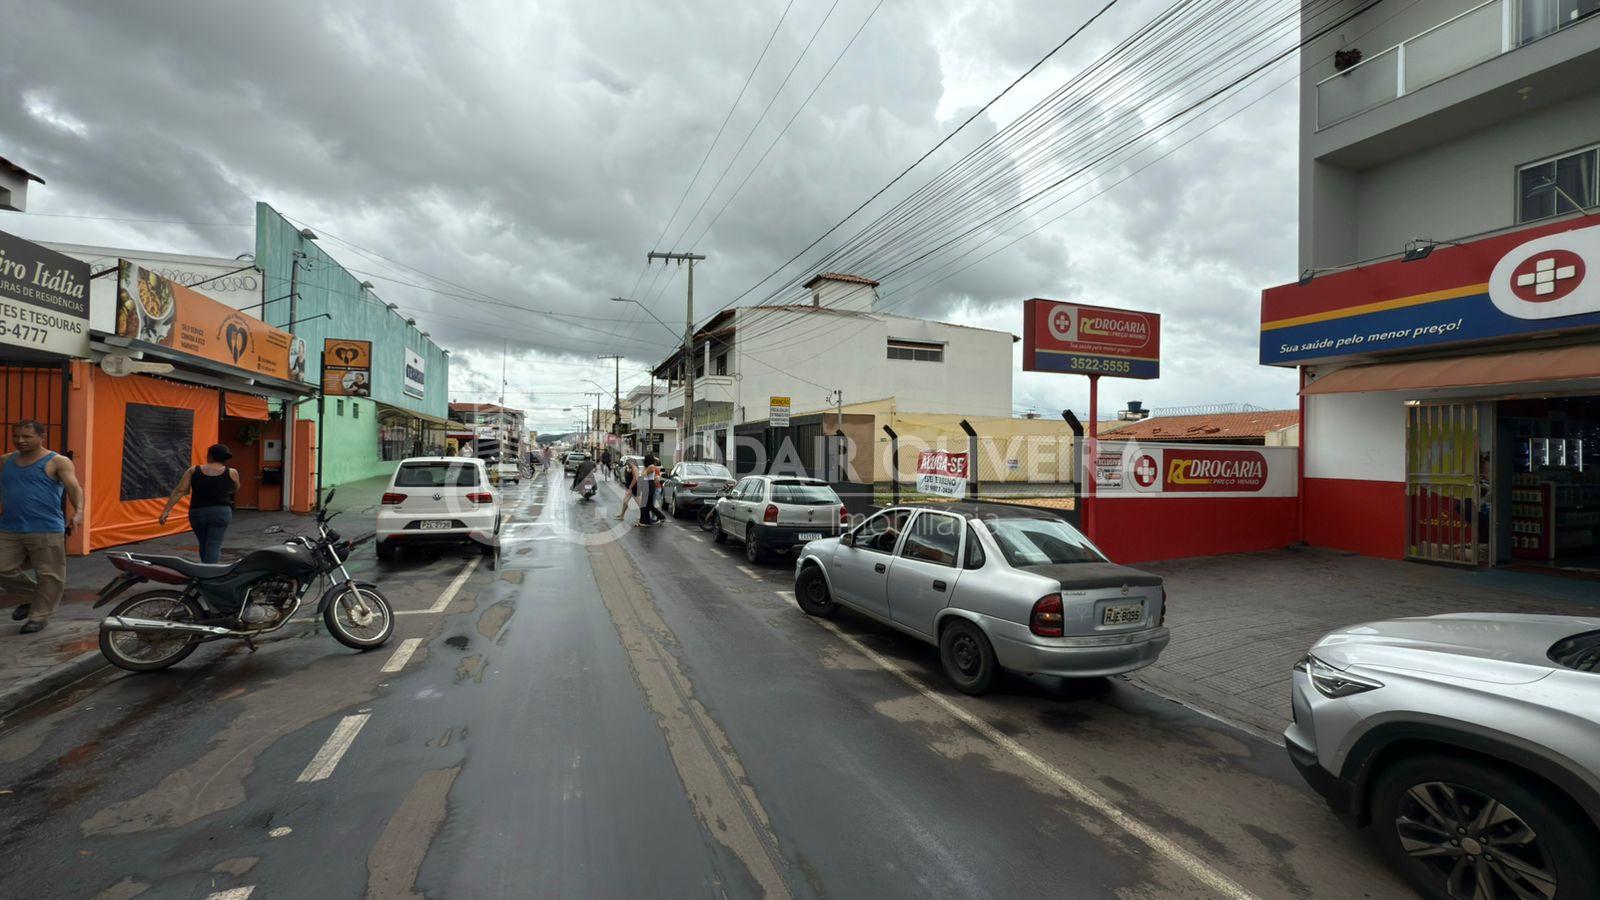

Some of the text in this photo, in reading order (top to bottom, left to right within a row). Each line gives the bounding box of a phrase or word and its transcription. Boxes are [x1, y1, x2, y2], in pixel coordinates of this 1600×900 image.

[0, 250, 84, 299] iro Itália
[22, 286, 34, 298] DE
[36, 290, 84, 312] RESIDÊNCIAS
[20, 308, 27, 321] E
[28, 310, 82, 335] TESOURAS
[1095, 318, 1146, 333] DROGARIA
[1280, 318, 1462, 354] Sua saúde pelo menor preço!
[1070, 357, 1130, 373] 3522-5555
[920, 455, 963, 472] ALUGA-SE
[1190, 459, 1262, 478] DROGARIA
